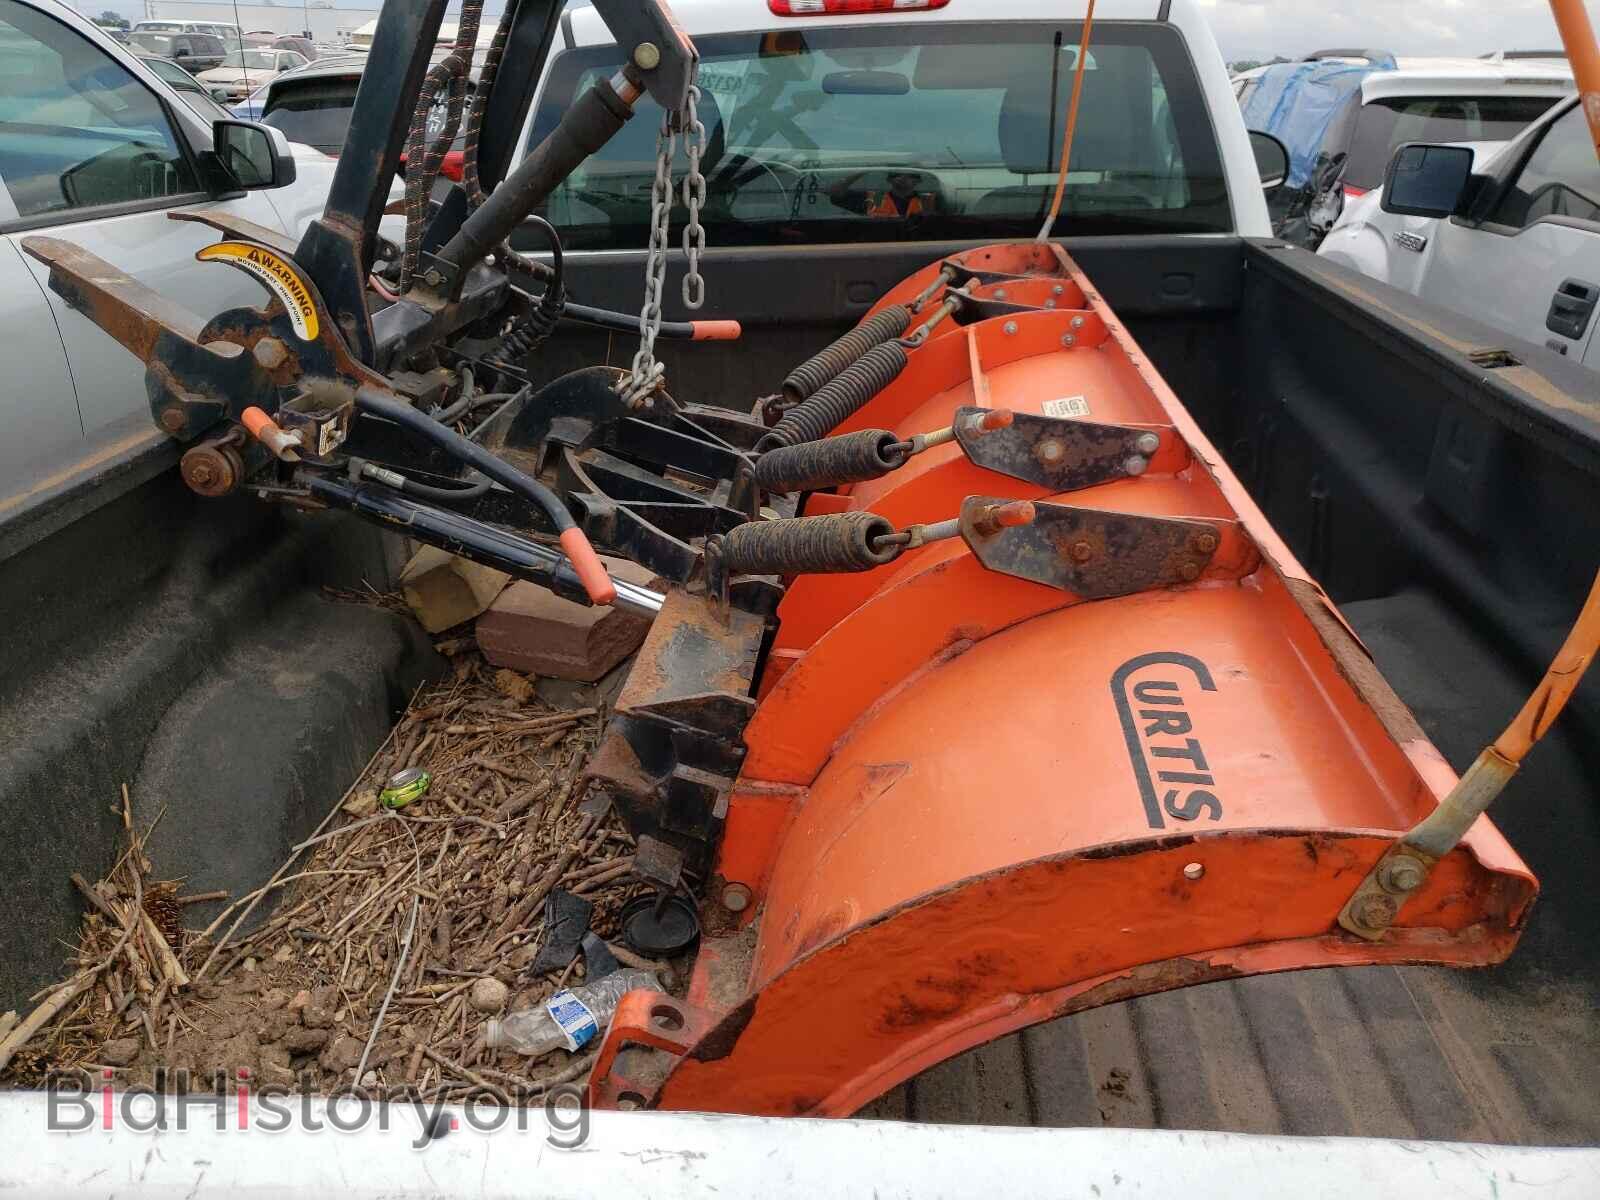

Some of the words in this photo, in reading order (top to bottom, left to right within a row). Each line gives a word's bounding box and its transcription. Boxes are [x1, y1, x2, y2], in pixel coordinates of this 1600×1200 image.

[237, 257, 262, 272] MOVING
[262, 270, 278, 284] PART
[279, 286, 294, 306] PINCH
[292, 305, 303, 327] POINT
[262, 254, 313, 317] WARNING
[1110, 651, 1223, 829] CURTIS
